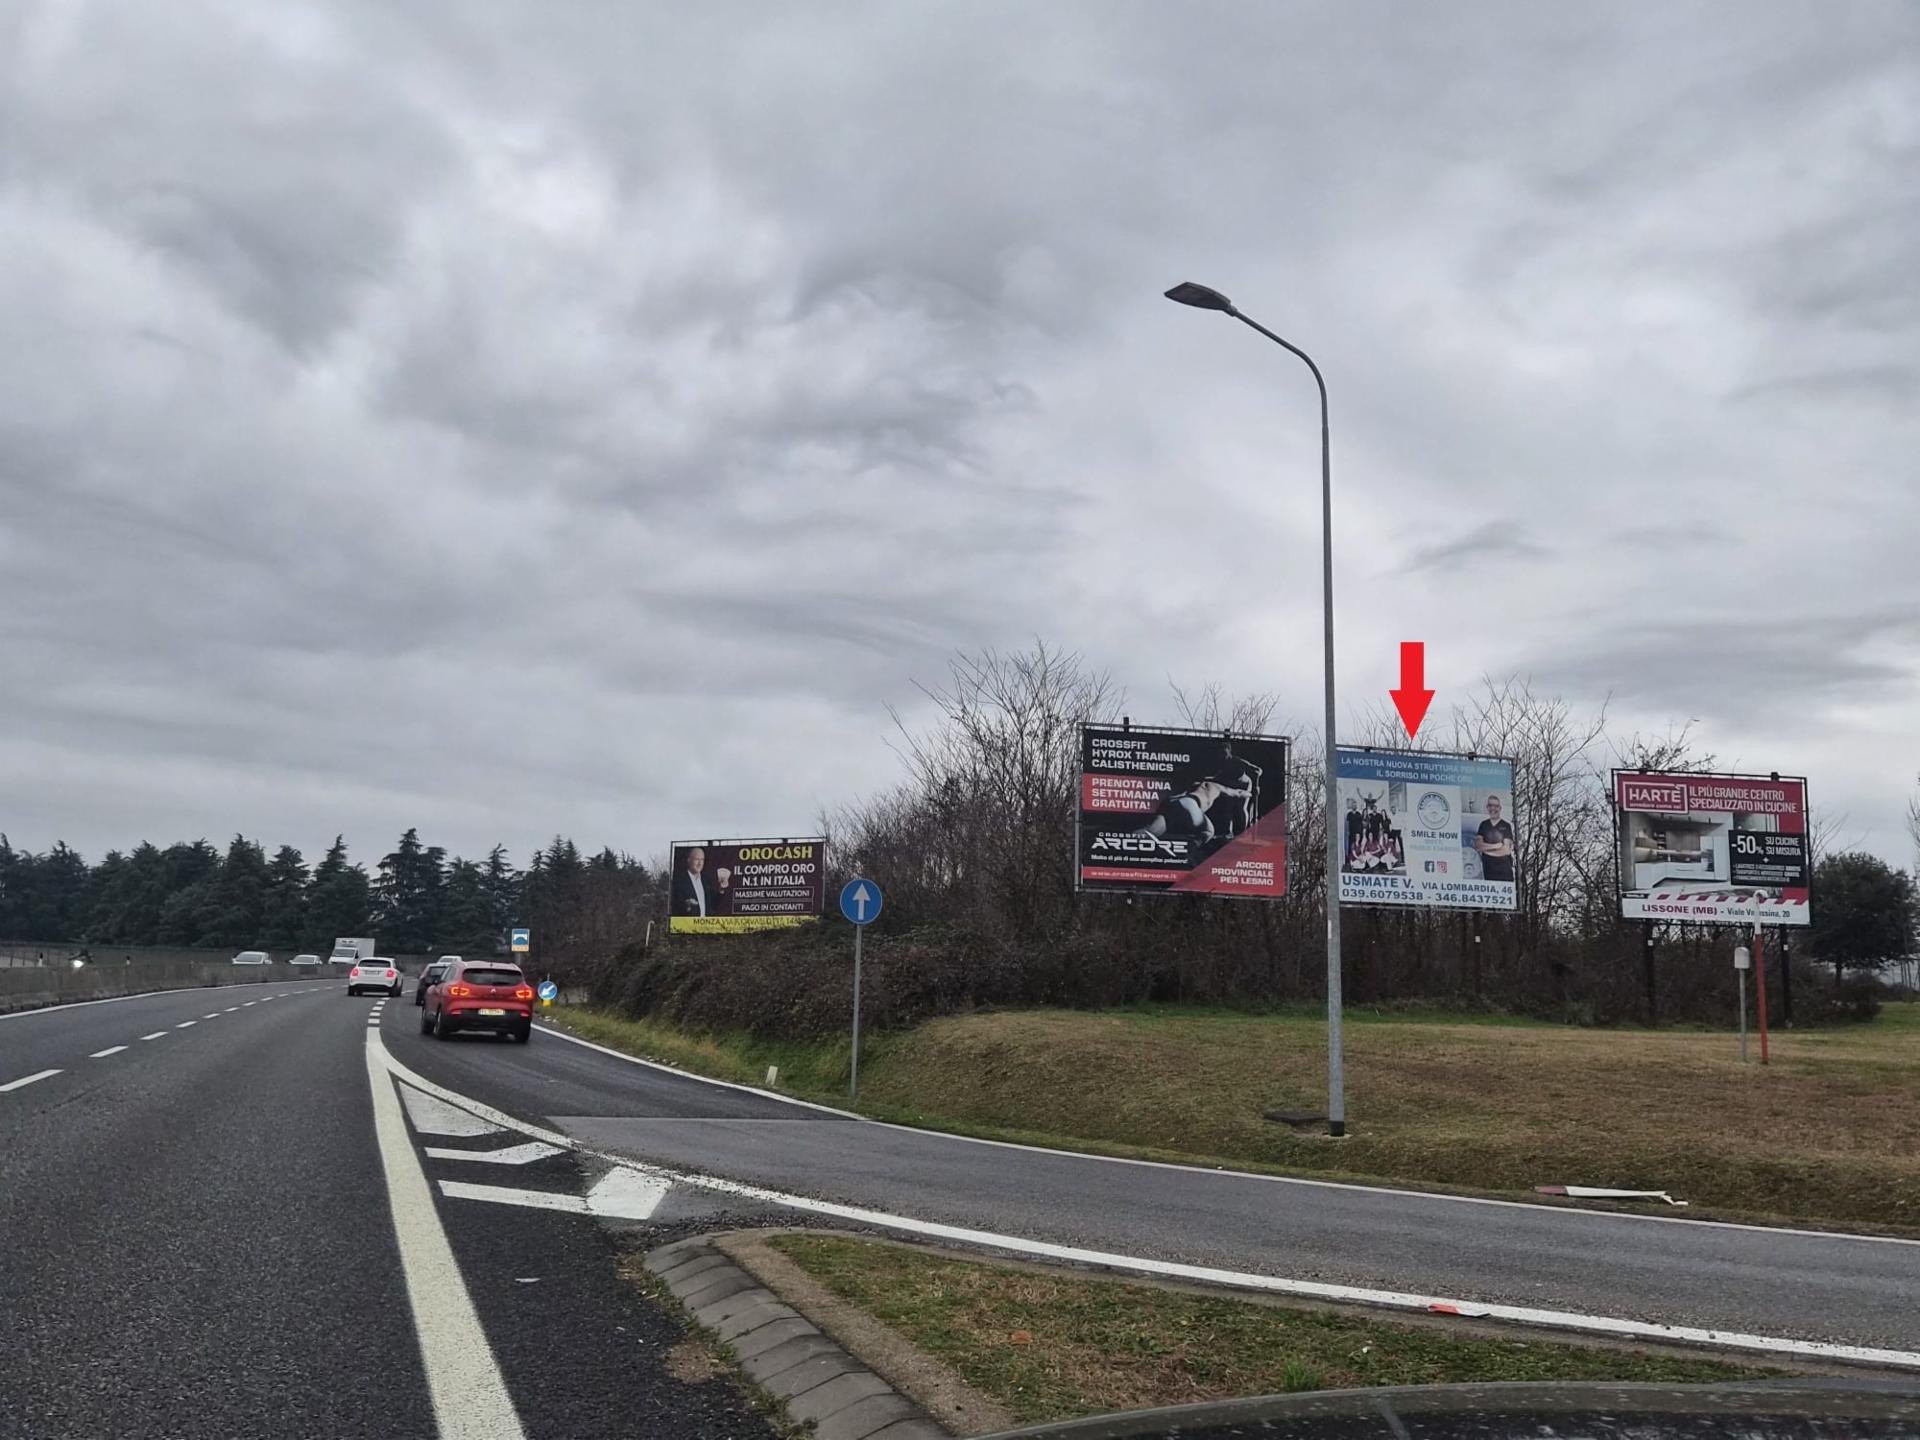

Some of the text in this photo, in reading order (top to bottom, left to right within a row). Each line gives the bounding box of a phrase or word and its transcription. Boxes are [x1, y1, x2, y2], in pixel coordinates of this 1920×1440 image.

[1092, 738, 1148, 750] CROSSFIT
[1092, 749, 1190, 762] HYROX TRAINING
[1092, 759, 1174, 772] CALISTHENICS
[1341, 757, 1352, 765] LA
[1353, 758, 1384, 767] NOSTRA
[1386, 761, 1413, 769] NUOVA
[1385, 770, 1418, 779] SORRISO
[1092, 778, 1172, 790] PRENOTA UNA
[1092, 788, 1160, 800] SETTIMANA
[1689, 784, 1784, 801] IL PIÙ GRANDE CENTRO
[1092, 799, 1150, 810] GRATUITA!
[1690, 798, 1797, 812] SPECIALIZZATO IN CUCINE
[1411, 830, 1436, 838] SMILE
[1091, 830, 1188, 857] ARCORE
[1765, 836, 1774, 845] SU
[1776, 837, 1800, 846] CUCINE
[1766, 846, 1802, 856] SU MISURA
[734, 863, 815, 875] IL COMPRO ORO
[1236, 861, 1274, 869] ARCORE
[1212, 868, 1274, 878] PROVINCIALE
[742, 875, 806, 886] N.1 IN ITALIA
[1220, 876, 1274, 886] PER LESMO
[1342, 876, 1513, 894] USMATE V. VIA LOMBARDIA, 46
[1342, 888, 1424, 900] 039.6079538
[1436, 893, 1512, 905] 346.8437521
[1642, 904, 1689, 914] LISSONE
[1692, 906, 1718, 916] (MB)
[1727, 908, 1744, 916] Viale
